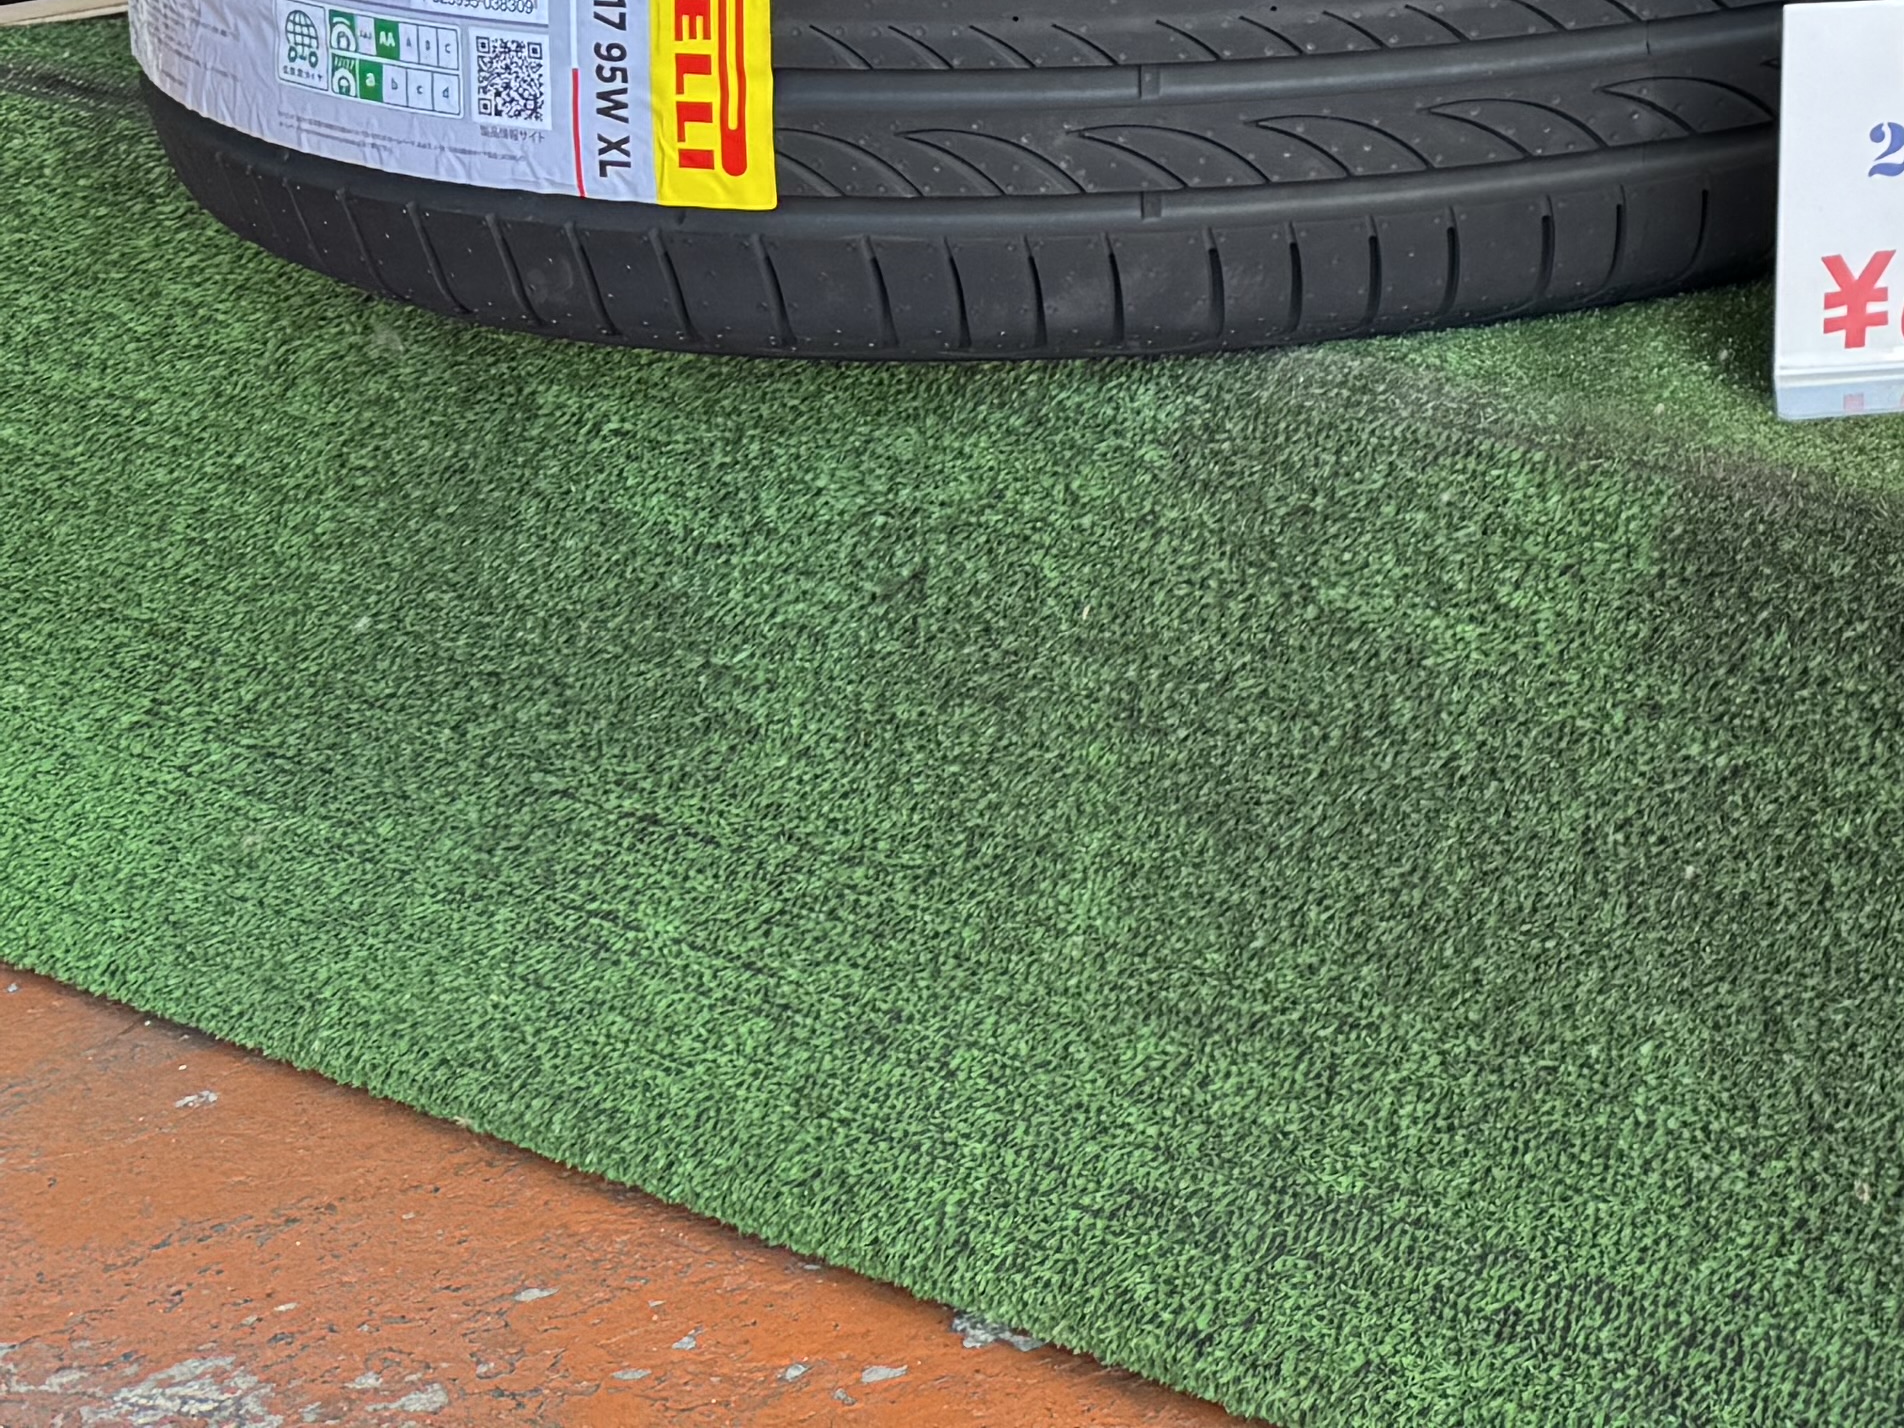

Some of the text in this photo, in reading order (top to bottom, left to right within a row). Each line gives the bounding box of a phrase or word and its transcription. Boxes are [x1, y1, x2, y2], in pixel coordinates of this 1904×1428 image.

[379, 30, 396, 48] AA
[594, 43, 629, 124] 95W
[598, 134, 629, 178] XL
